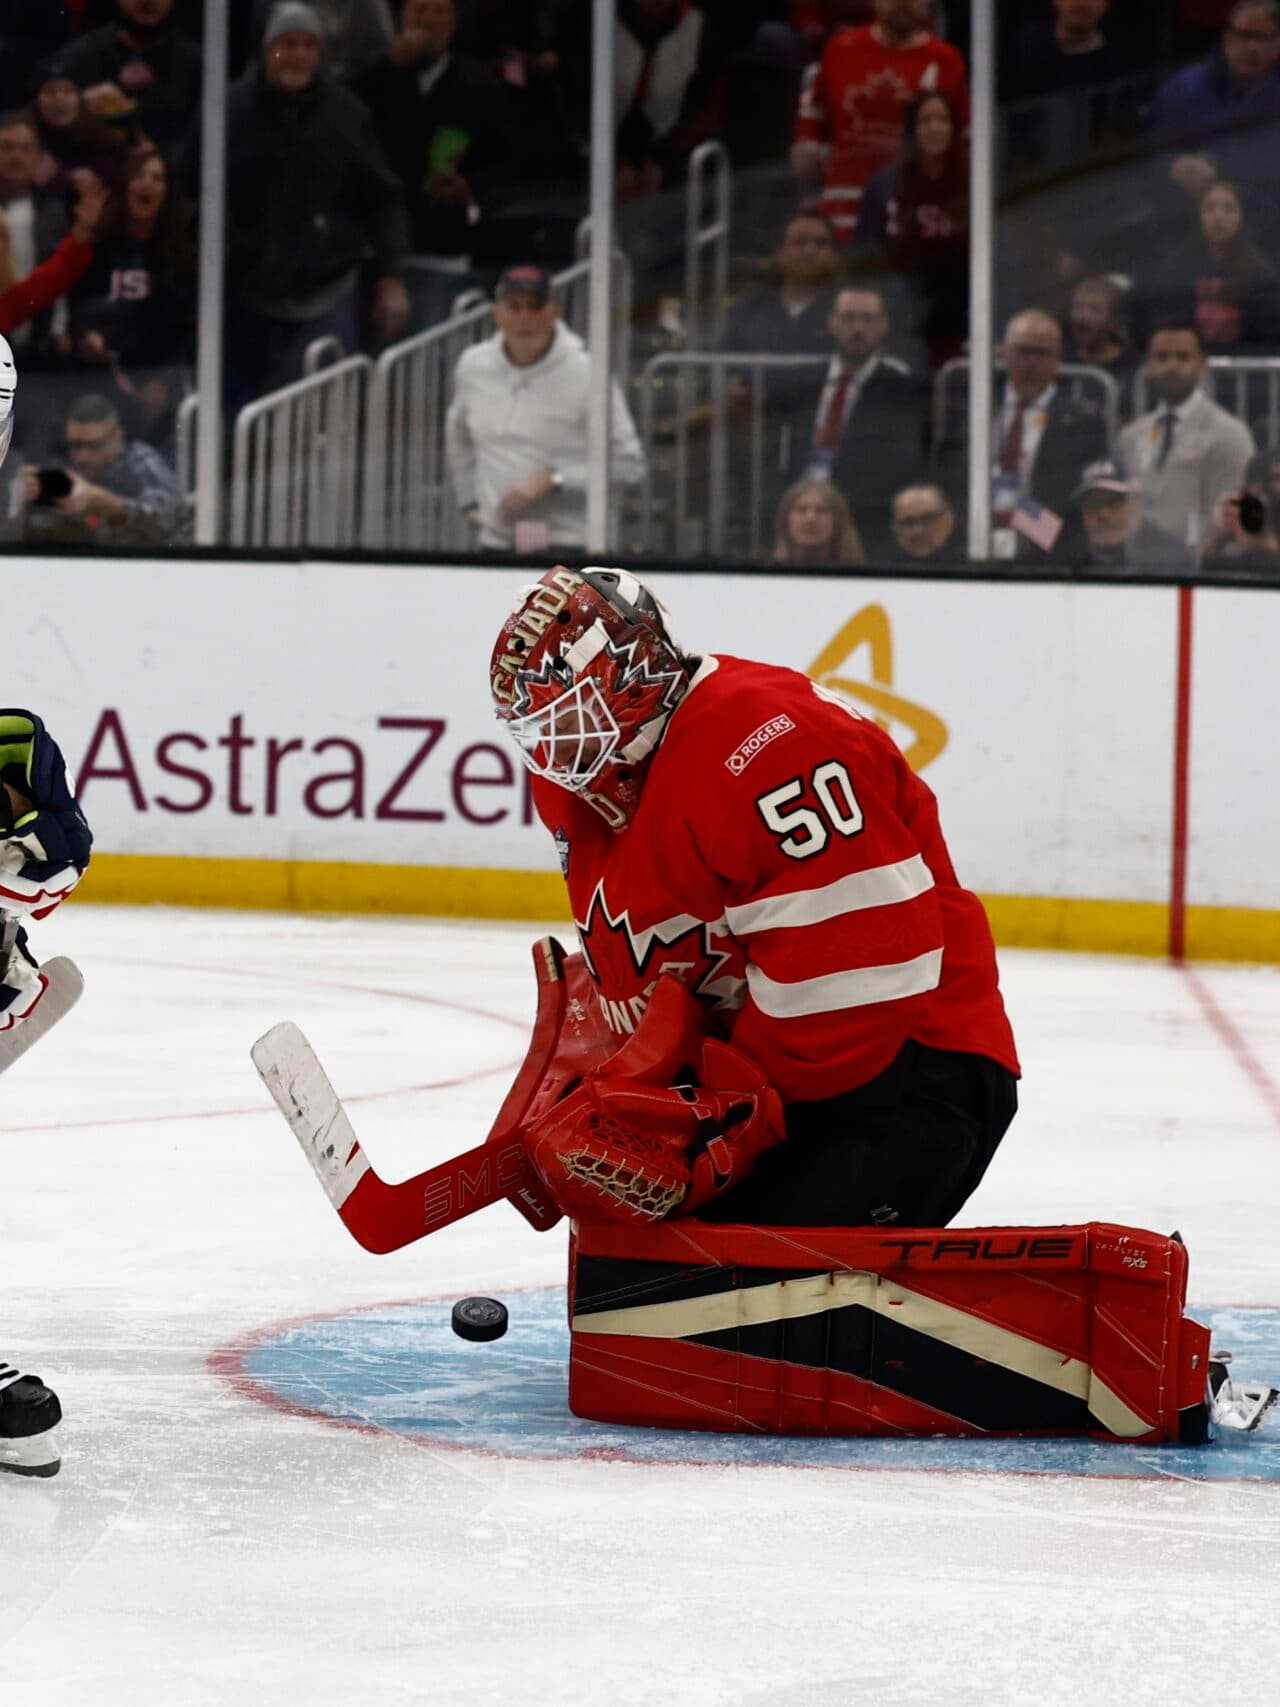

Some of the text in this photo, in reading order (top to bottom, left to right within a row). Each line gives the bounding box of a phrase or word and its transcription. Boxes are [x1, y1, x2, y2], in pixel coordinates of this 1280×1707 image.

[492, 570, 585, 704] CANADA
[741, 716, 792, 758] ROGERS
[754, 758, 867, 862] 50
[879, 1237, 1076, 1263] TRUE
